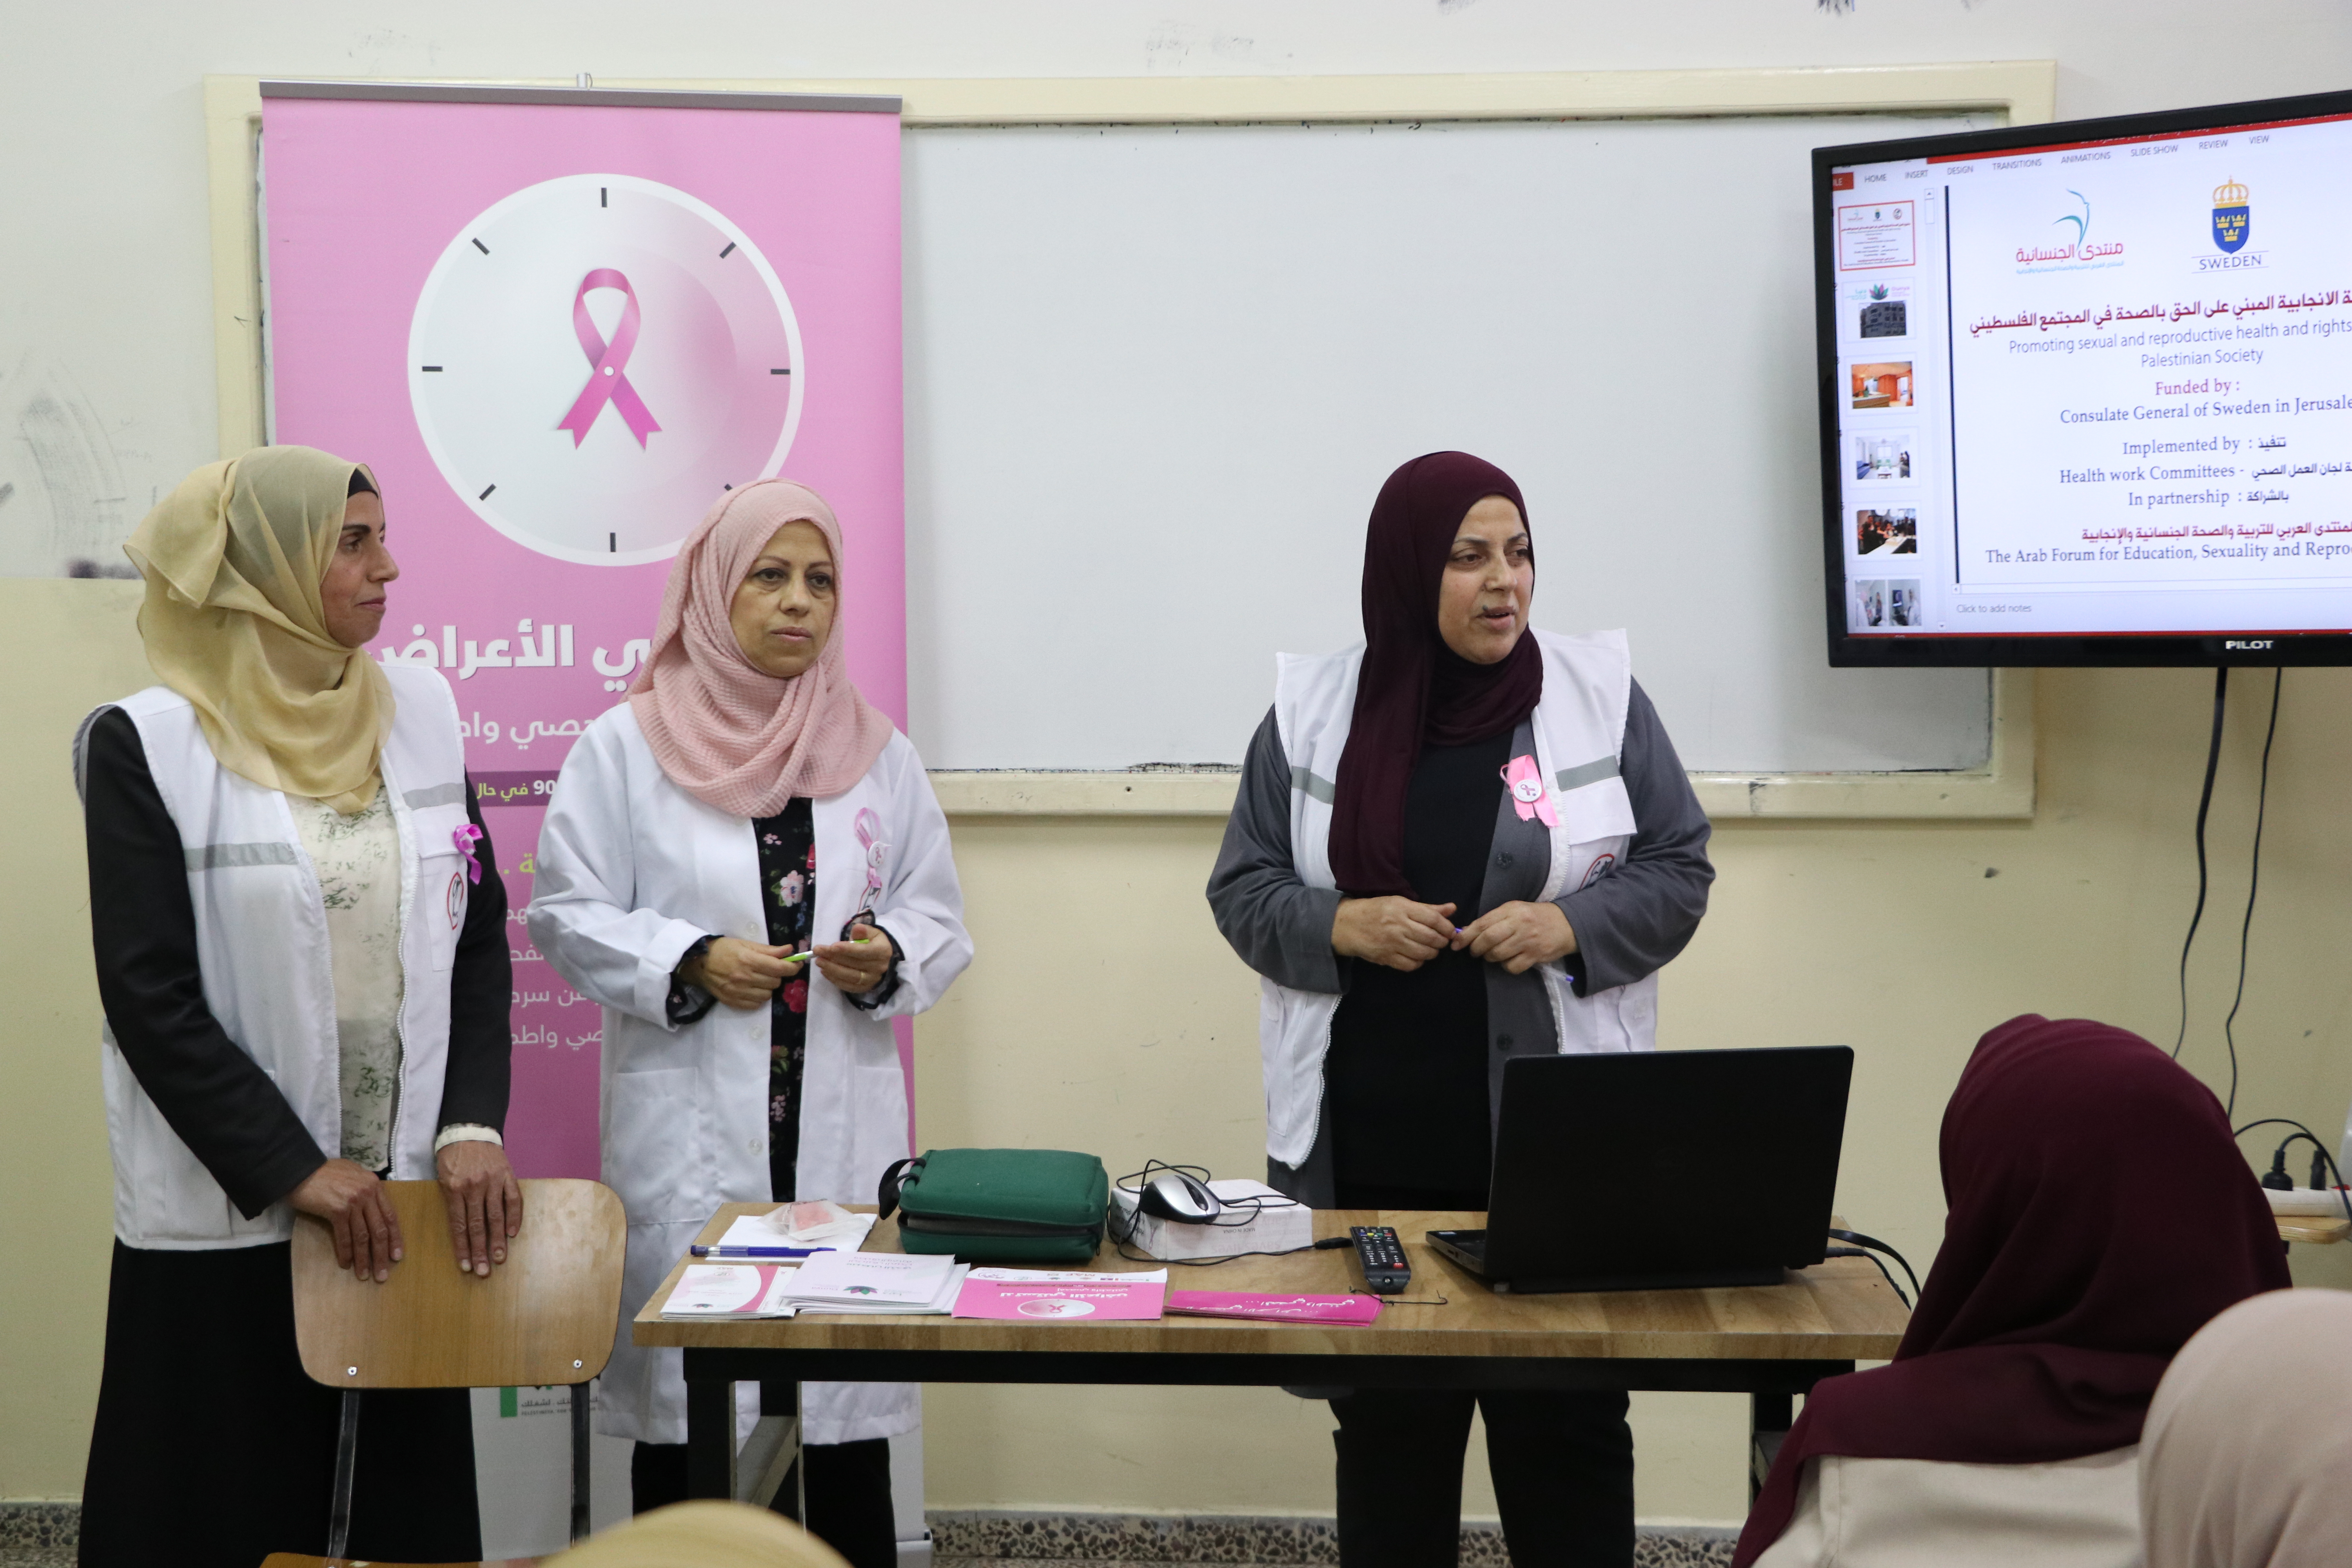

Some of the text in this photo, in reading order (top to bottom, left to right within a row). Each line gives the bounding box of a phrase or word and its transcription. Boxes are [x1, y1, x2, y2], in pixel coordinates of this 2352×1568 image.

[1865, 174, 1886, 183] HOME
[1905, 170, 1928, 179] INSERT
[1947, 166, 1973, 175] DESIGN
[1992, 159, 2042, 170] TRANSITIONS
[2061, 152, 2111, 164] ANIMATIONS
[2131, 147, 2151, 157] SLIDE
[2154, 145, 2178, 155] SHOW
[2199, 140, 2229, 149] REVIEW
[2249, 135, 2270, 144] VIEW
[2016, 243, 2123, 265] منتدى الجنسانية
[2199, 254, 2261, 270] SWEDEN
[2093, 304, 2112, 330] في
[2116, 303, 2165, 322] بالصحة
[2169, 300, 2201, 322] الحق
[2204, 299, 2229, 318] على
[2232, 295, 2274, 321] المبني
[1970, 310, 2037, 338] الفلسطيني
[2040, 308, 2090, 331] المجتمع
[2010, 318, 2352, 354] Promoting sexual and reproductive health and rights
[2141, 348, 2264, 368] Palestinian Society
[2155, 378, 2209, 396] Funded
[2214, 378, 2232, 396] by
[2060, 407, 2129, 423] Consulate
[2134, 403, 2189, 420] General
[2194, 401, 2208, 417] of
[2213, 399, 2270, 416] Sweden
[2275, 398, 2290, 413] in
[2122, 436, 2217, 458] Implemented
[2223, 436, 2240, 455] by
[2258, 435, 2286, 452] تنفيذ
[2060, 468, 2105, 483] Health
[2109, 466, 2146, 481] work
[2150, 464, 2235, 481] Committees
[2252, 464, 2286, 481] الصحي
[2288, 463, 2318, 478] العمل
[2319, 462, 2343, 476] لجان
[2128, 492, 2143, 506] In
[2148, 489, 2229, 509] partnership
[2247, 489, 2289, 504] بالشراكة
[2136, 526, 2189, 542] الجنسانية
[2192, 524, 2234, 540] والصحة
[2237, 523, 2274, 539] للتربية
[2276, 522, 2311, 541] العربي
[1986, 542, 2352, 563] The Arab Forum for Education, Sexuality and Repro
[1956, 604, 1976, 613] Click
[1989, 604, 2006, 612] add
[2225, 641, 2274, 650] PILOT
[500, 783, 529, 802] في
